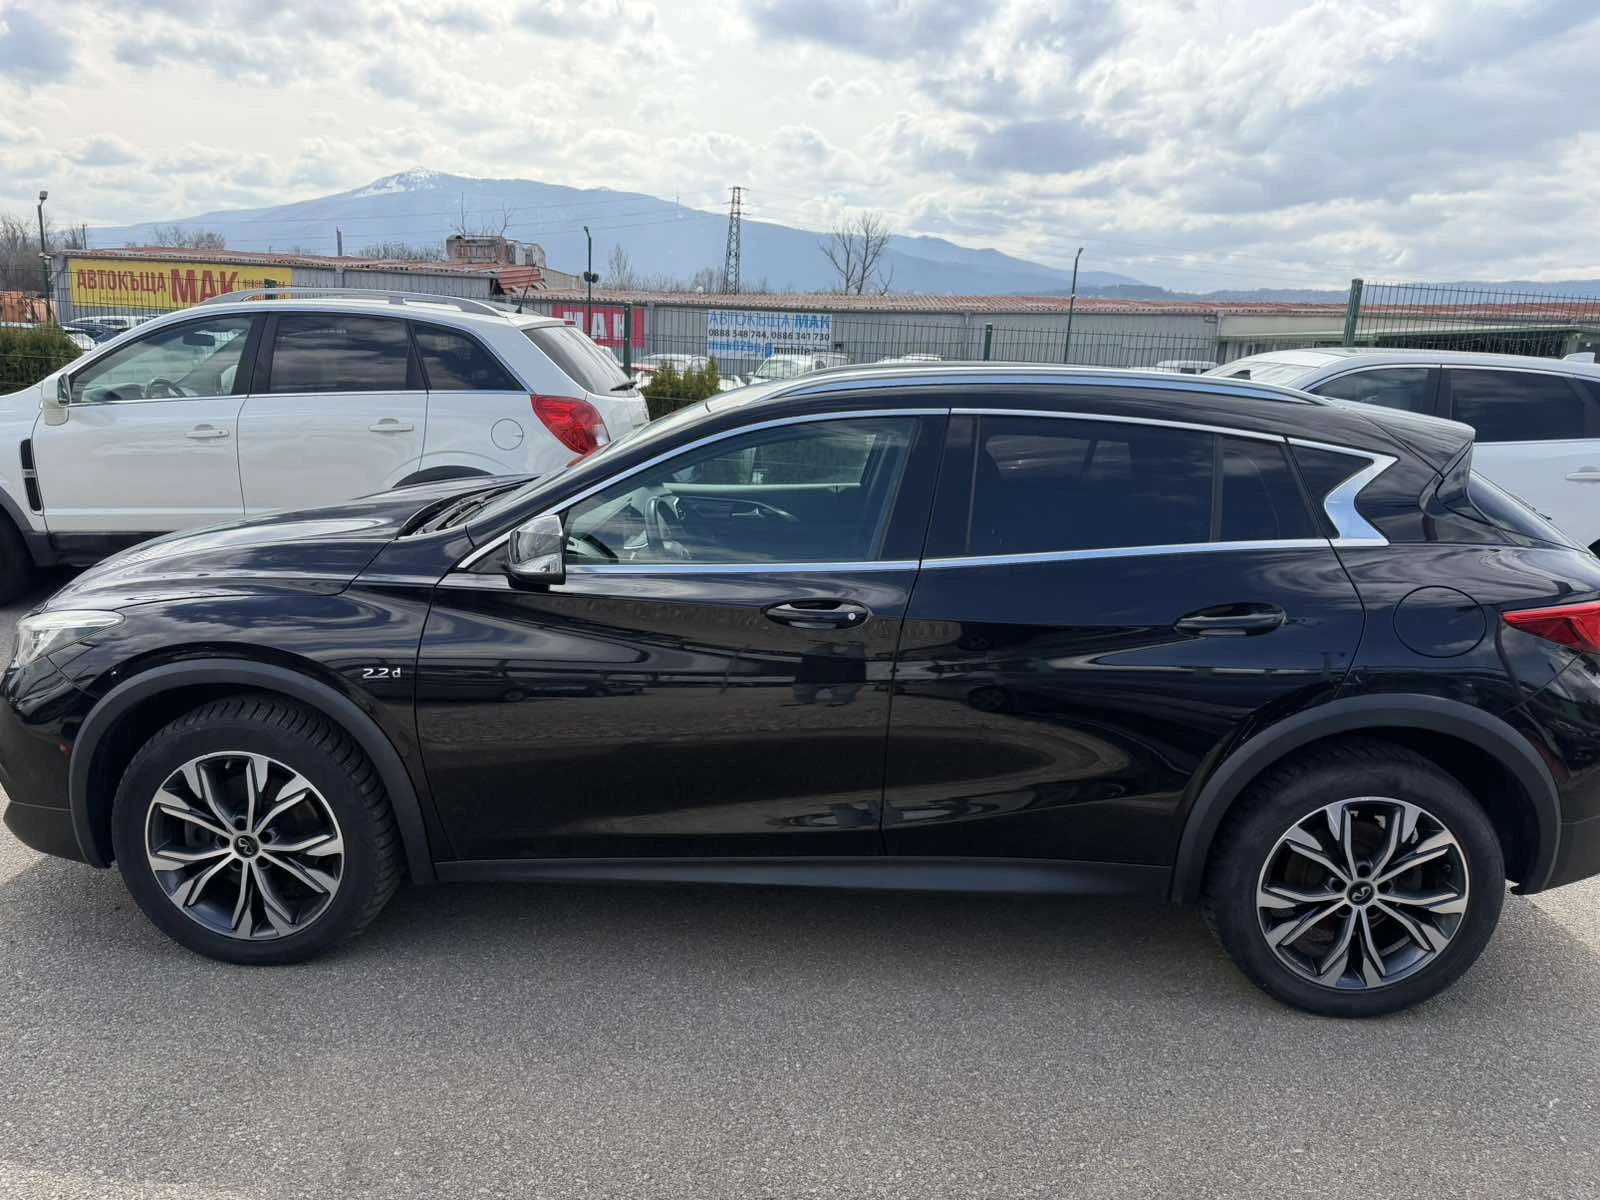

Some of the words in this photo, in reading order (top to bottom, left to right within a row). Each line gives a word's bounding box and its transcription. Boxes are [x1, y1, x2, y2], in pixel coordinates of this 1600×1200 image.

[77, 269, 167, 295] АВТОКЪЩА
[170, 268, 239, 304] МАК
[709, 311, 789, 328] АВТОКЪЩА
[795, 314, 830, 329] МАК
[708, 328, 729, 338] 0888
[770, 331, 794, 340] 0886
[813, 333, 830, 342] 730
